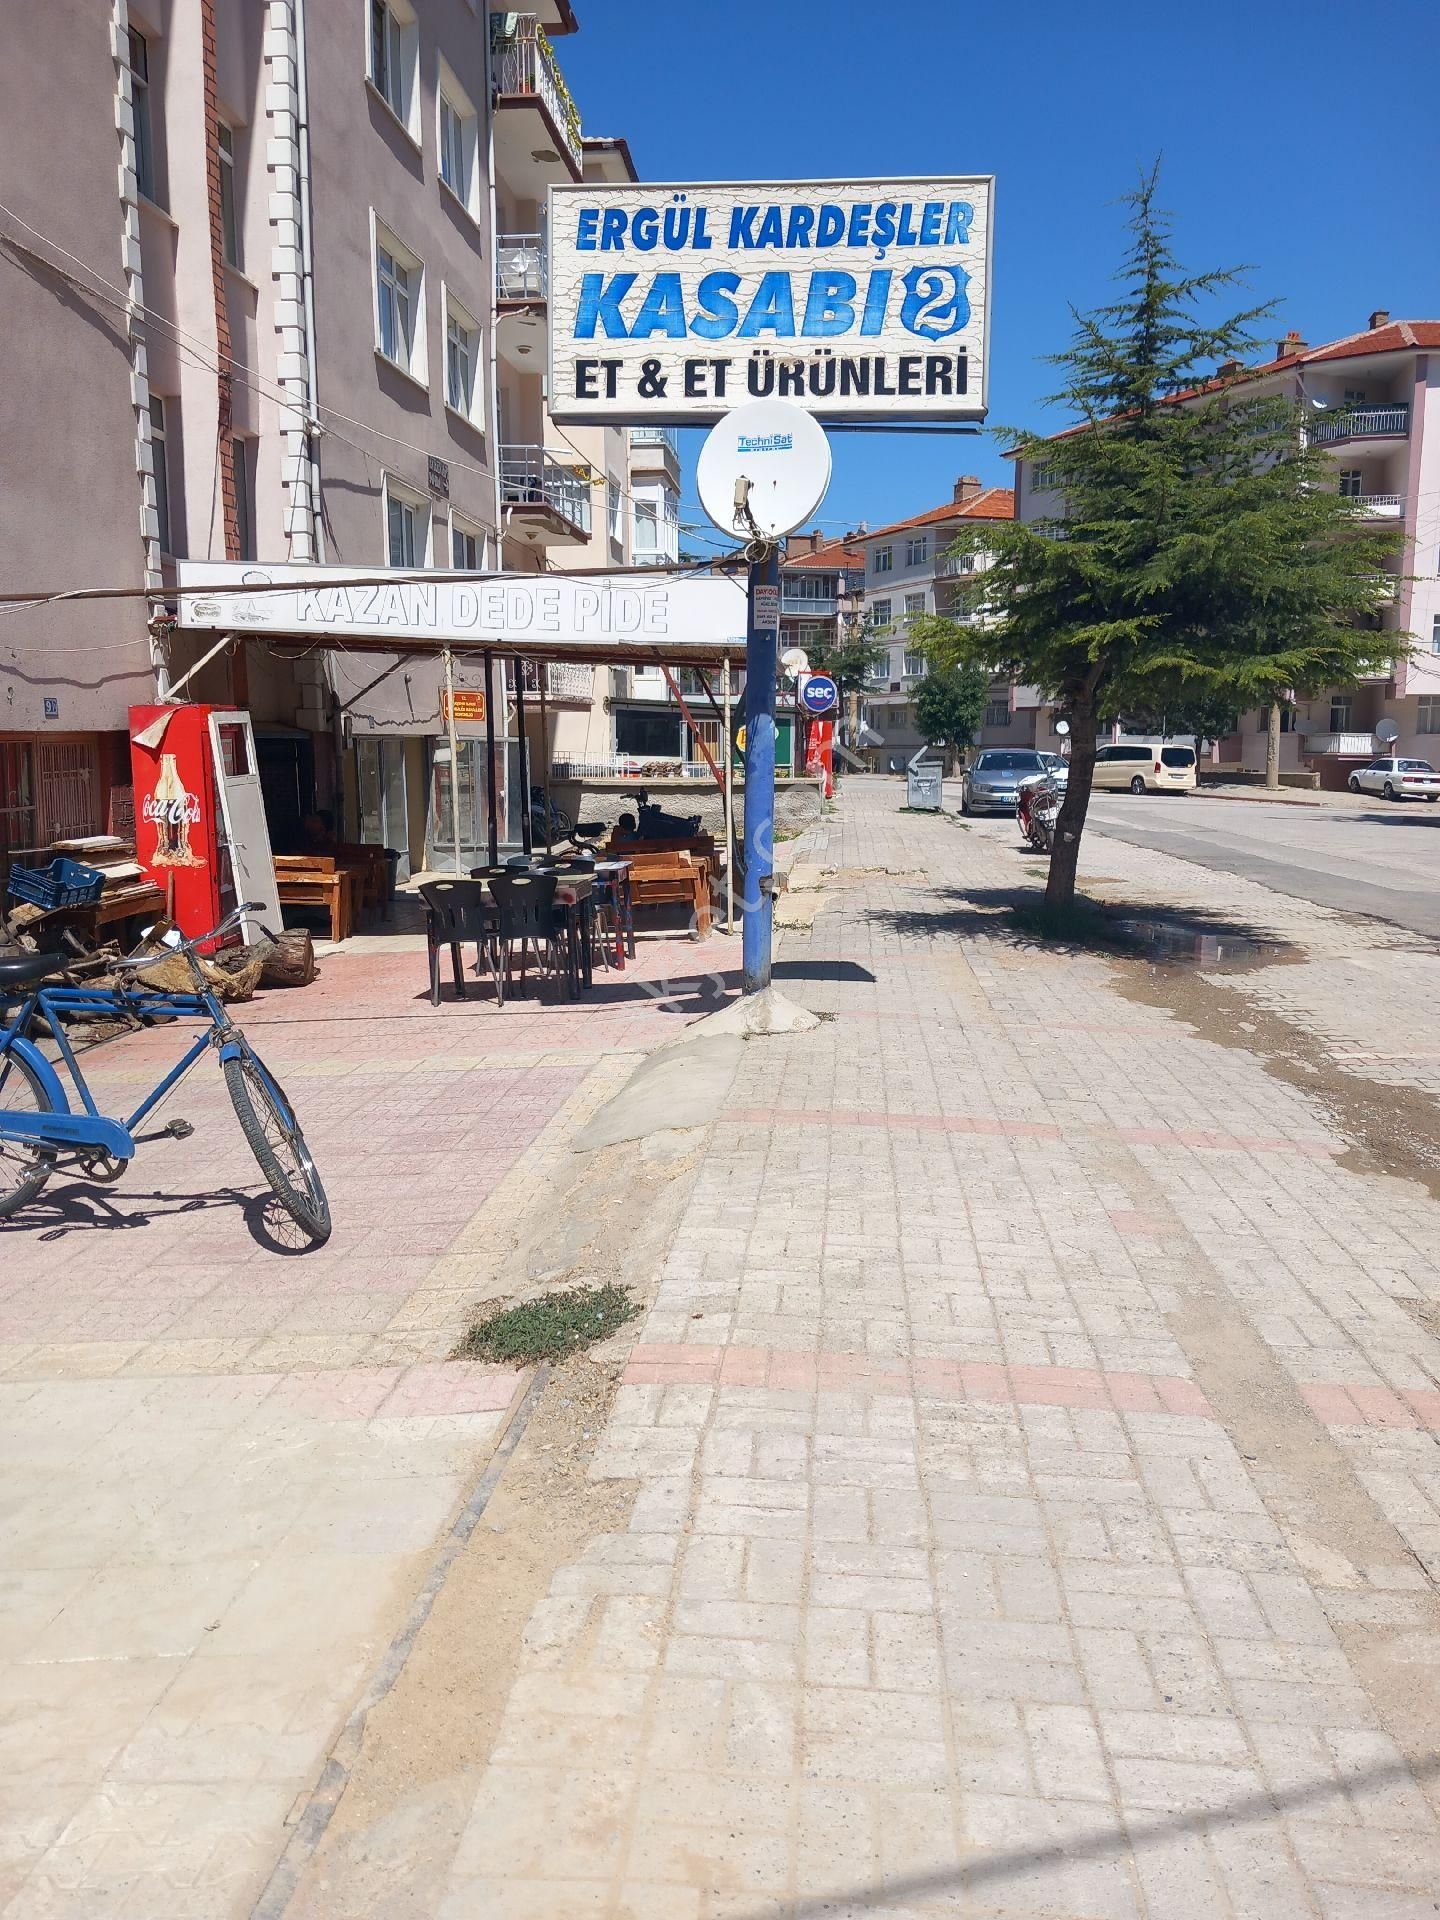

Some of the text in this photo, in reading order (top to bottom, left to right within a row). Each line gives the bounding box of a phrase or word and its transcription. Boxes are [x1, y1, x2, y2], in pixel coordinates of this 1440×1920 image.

[575, 193, 974, 261] ERGÜL KARDEŞLER
[572, 269, 958, 339] KASABI 2
[574, 345, 968, 399] ET & ET ÜRÜNLERİ
[737, 433, 793, 447] TechniSat
[297, 578, 669, 634] KAZAN DEDE PİDE
[807, 686, 833, 700] seç
